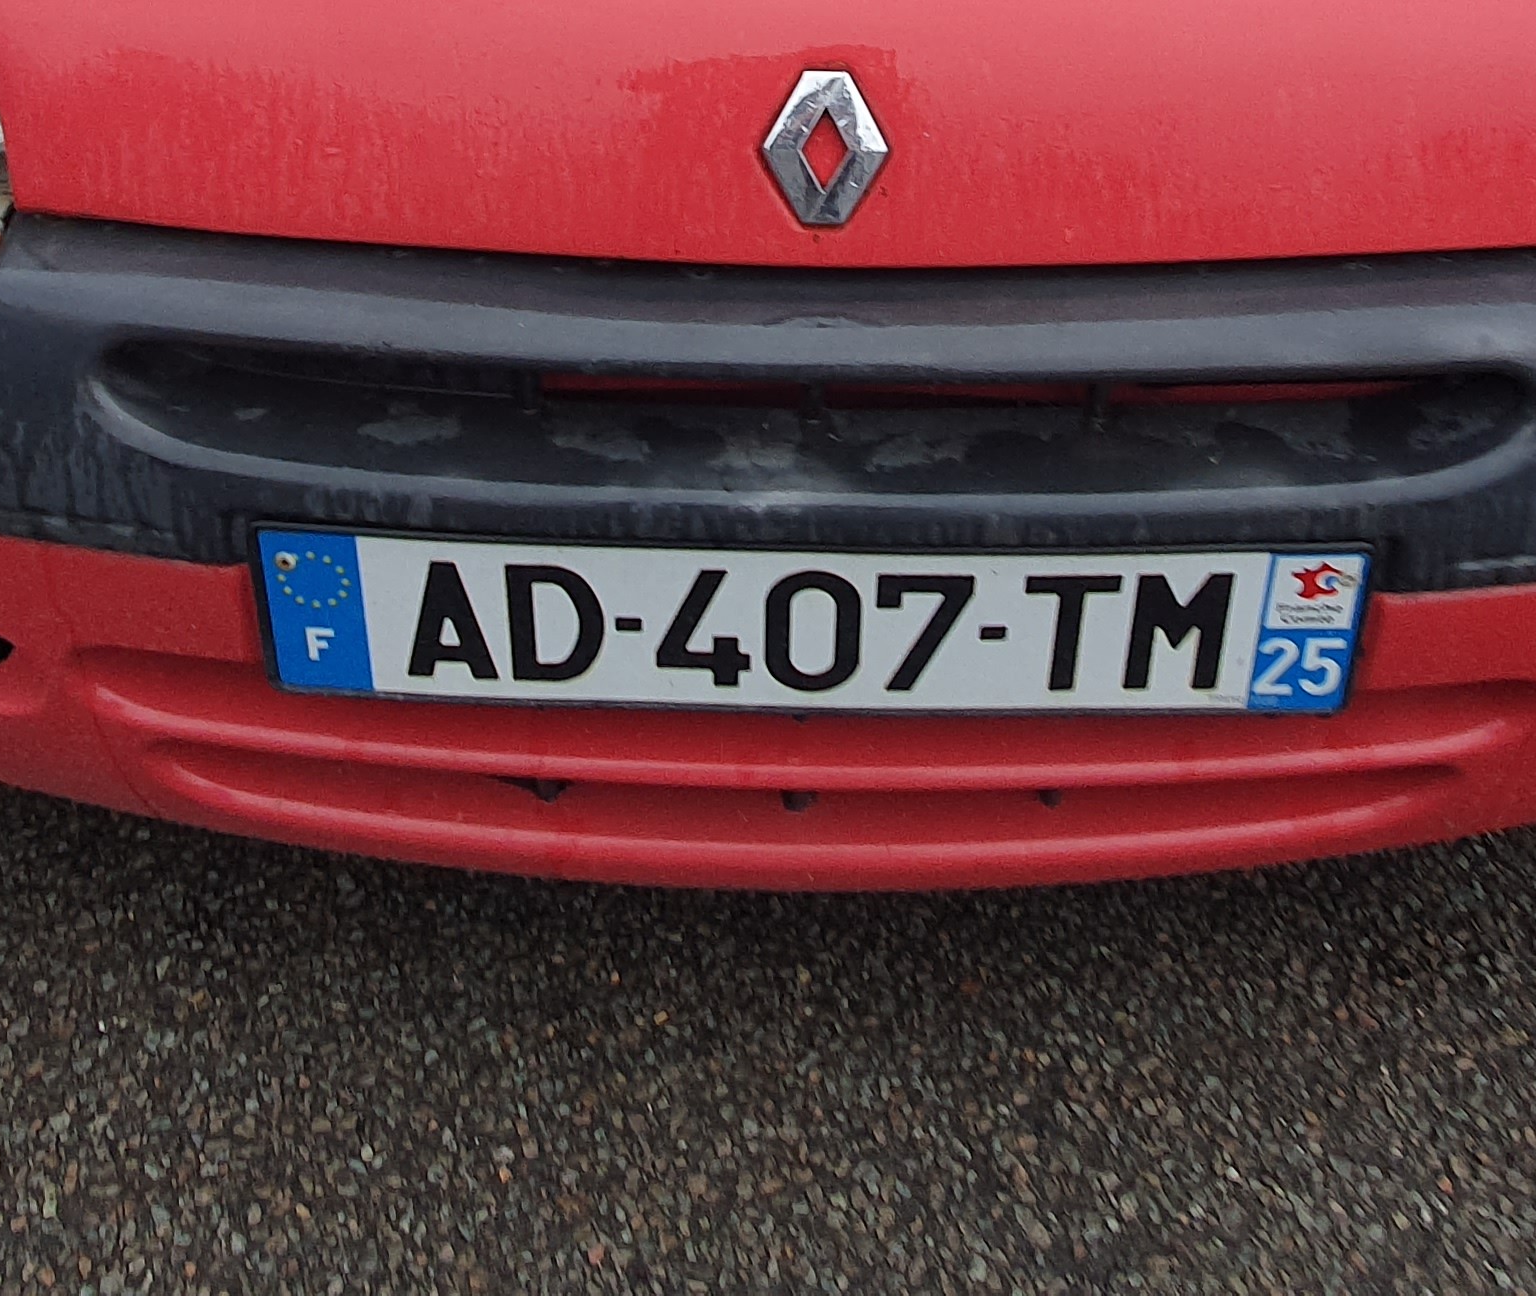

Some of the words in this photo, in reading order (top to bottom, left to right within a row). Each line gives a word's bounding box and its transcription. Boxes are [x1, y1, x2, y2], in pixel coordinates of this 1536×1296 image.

[305, 627, 335, 662] F
[408, 560, 1235, 695] AD-407-TM
[1252, 637, 1348, 696] 25
